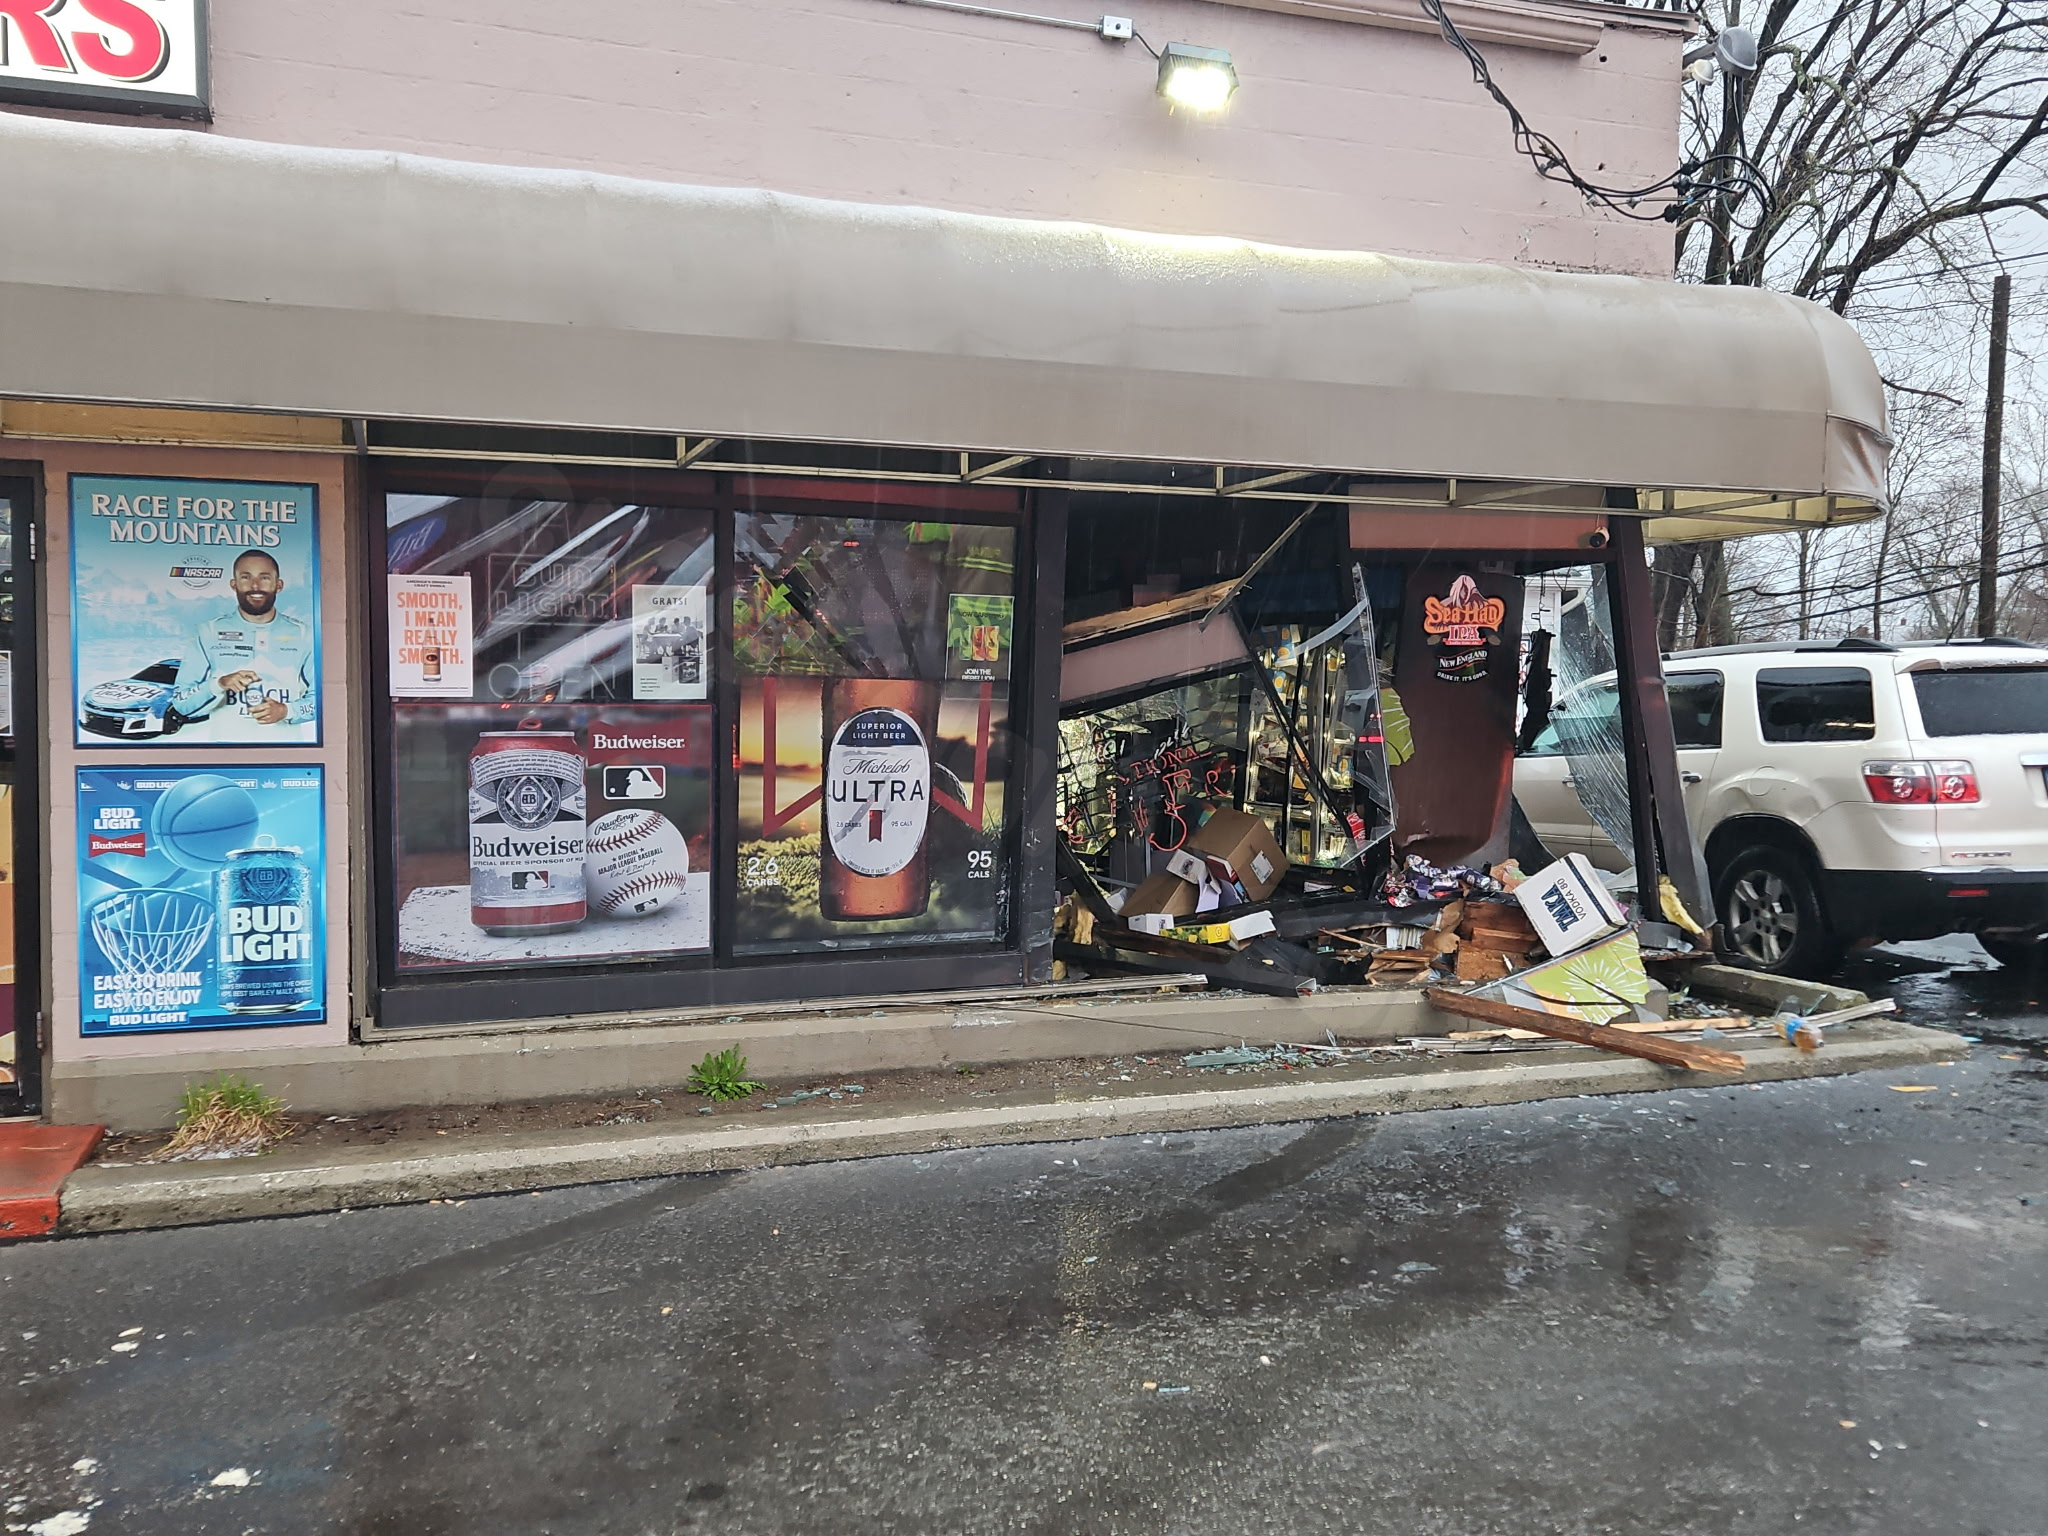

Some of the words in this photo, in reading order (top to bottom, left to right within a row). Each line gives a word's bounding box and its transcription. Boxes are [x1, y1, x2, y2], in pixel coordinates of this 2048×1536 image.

[91, 494, 169, 517] RACE
[176, 497, 236, 521] FOR
[242, 500, 297, 523] THE
[109, 520, 281, 547] MOUNTAINS
[183, 568, 222, 577] NASCAR
[397, 592, 463, 610] SMOOTH,
[496, 592, 609, 617] LIGHT
[652, 597, 687, 606] GRATSI
[405, 611, 410, 627] I
[415, 611, 456, 627] MEAN
[404, 629, 458, 646] REALLY
[1448, 625, 1480, 640] IPA
[399, 647, 464, 664] SMTH.
[1456, 650, 1488, 666] ENGLAND
[226, 688, 290, 706] BUCH
[593, 734, 685, 749] Budweiser
[843, 759, 912, 775] Michelob
[832, 780, 925, 802] ULTRA
[100, 808, 135, 818] BUD
[94, 818, 141, 829] LIGHT
[594, 812, 639, 835] Rawlings
[92, 841, 144, 849] Budweiser
[472, 836, 583, 857] Budweiser
[598, 863, 618, 875] MAJOR
[617, 856, 637, 868] LEAGUE
[637, 847, 663, 861] BASEBALL
[747, 856, 779, 876] 2.6
[967, 850, 992, 869] 95
[746, 878, 780, 886] CARBS
[967, 871, 990, 879] CALS
[1557, 877, 1569, 890] 80
[1565, 889, 1587, 920] VODKA
[228, 906, 303, 934] BUD
[220, 934, 310, 963] LIGHT
[94, 975, 131, 991] EASY
[135, 973, 153, 988] TO
[156, 971, 201, 987] DRINK
[94, 992, 131, 1009] EASY
[136, 991, 153, 1006] TO
[155, 989, 201, 1006] ENJOY
[110, 1015, 141, 1026] BUD
[143, 1012, 187, 1024] LIGHT
